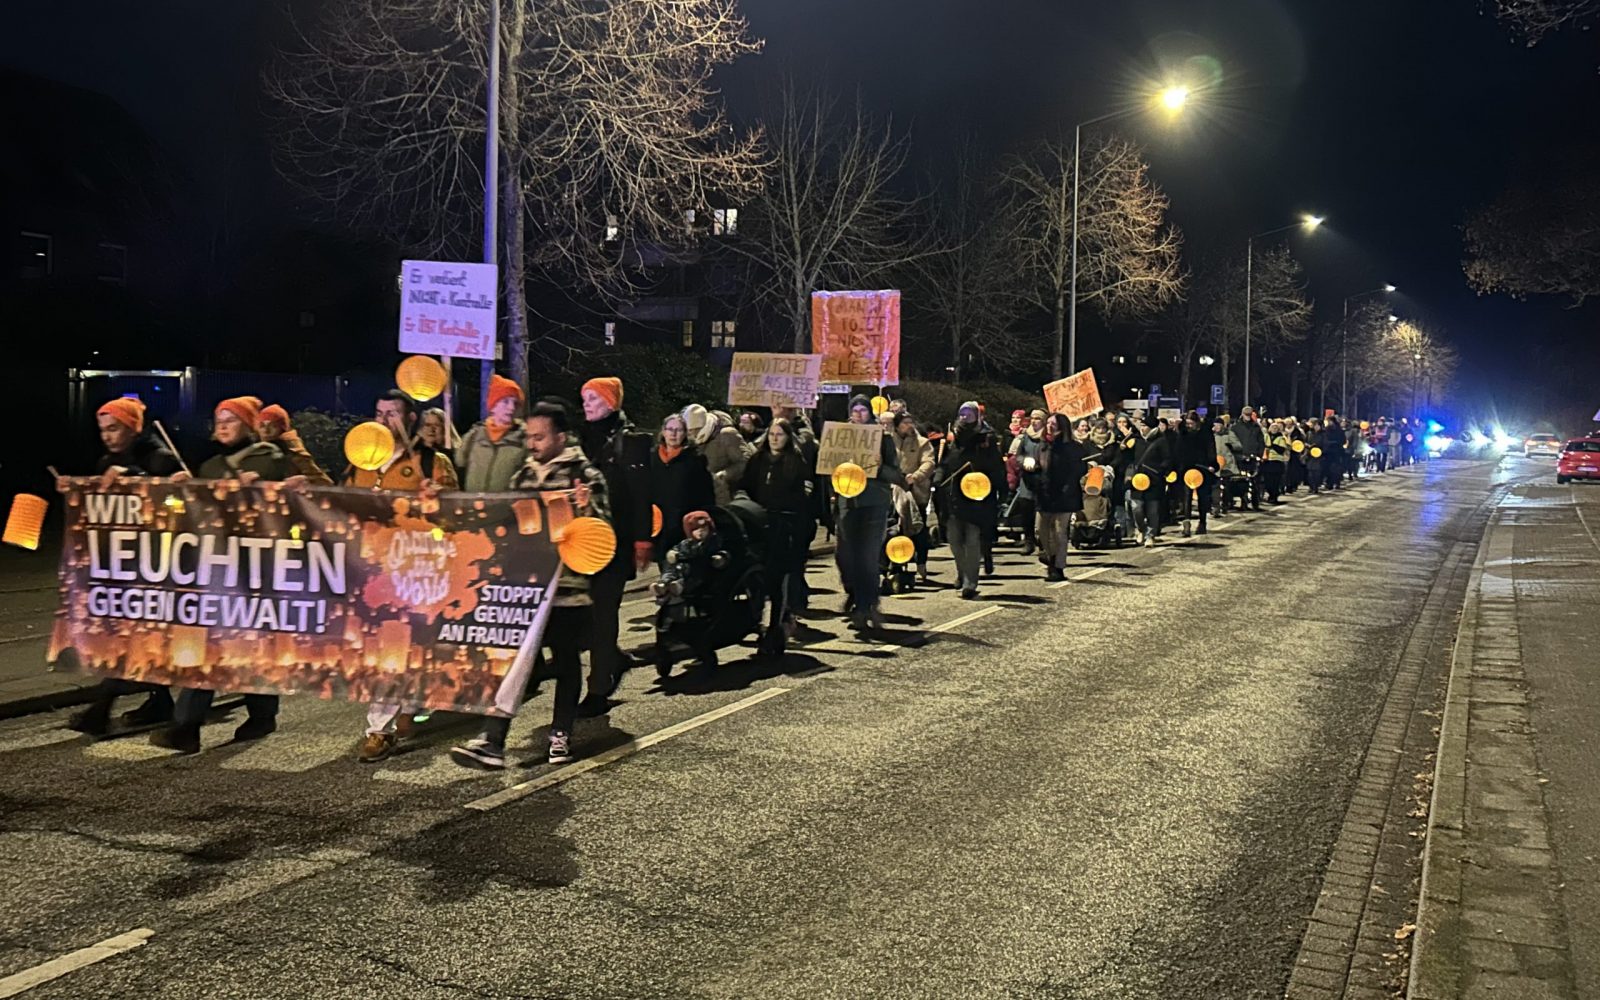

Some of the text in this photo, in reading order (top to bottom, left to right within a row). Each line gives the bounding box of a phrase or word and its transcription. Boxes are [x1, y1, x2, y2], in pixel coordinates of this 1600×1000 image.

[85, 494, 144, 525] WIR
[87, 529, 346, 594] LEUCHTEN
[391, 570, 450, 605] World
[480, 584, 544, 605] STOPPT
[88, 586, 327, 634] GEGEN GEWALT!
[438, 624, 464, 642] AN
